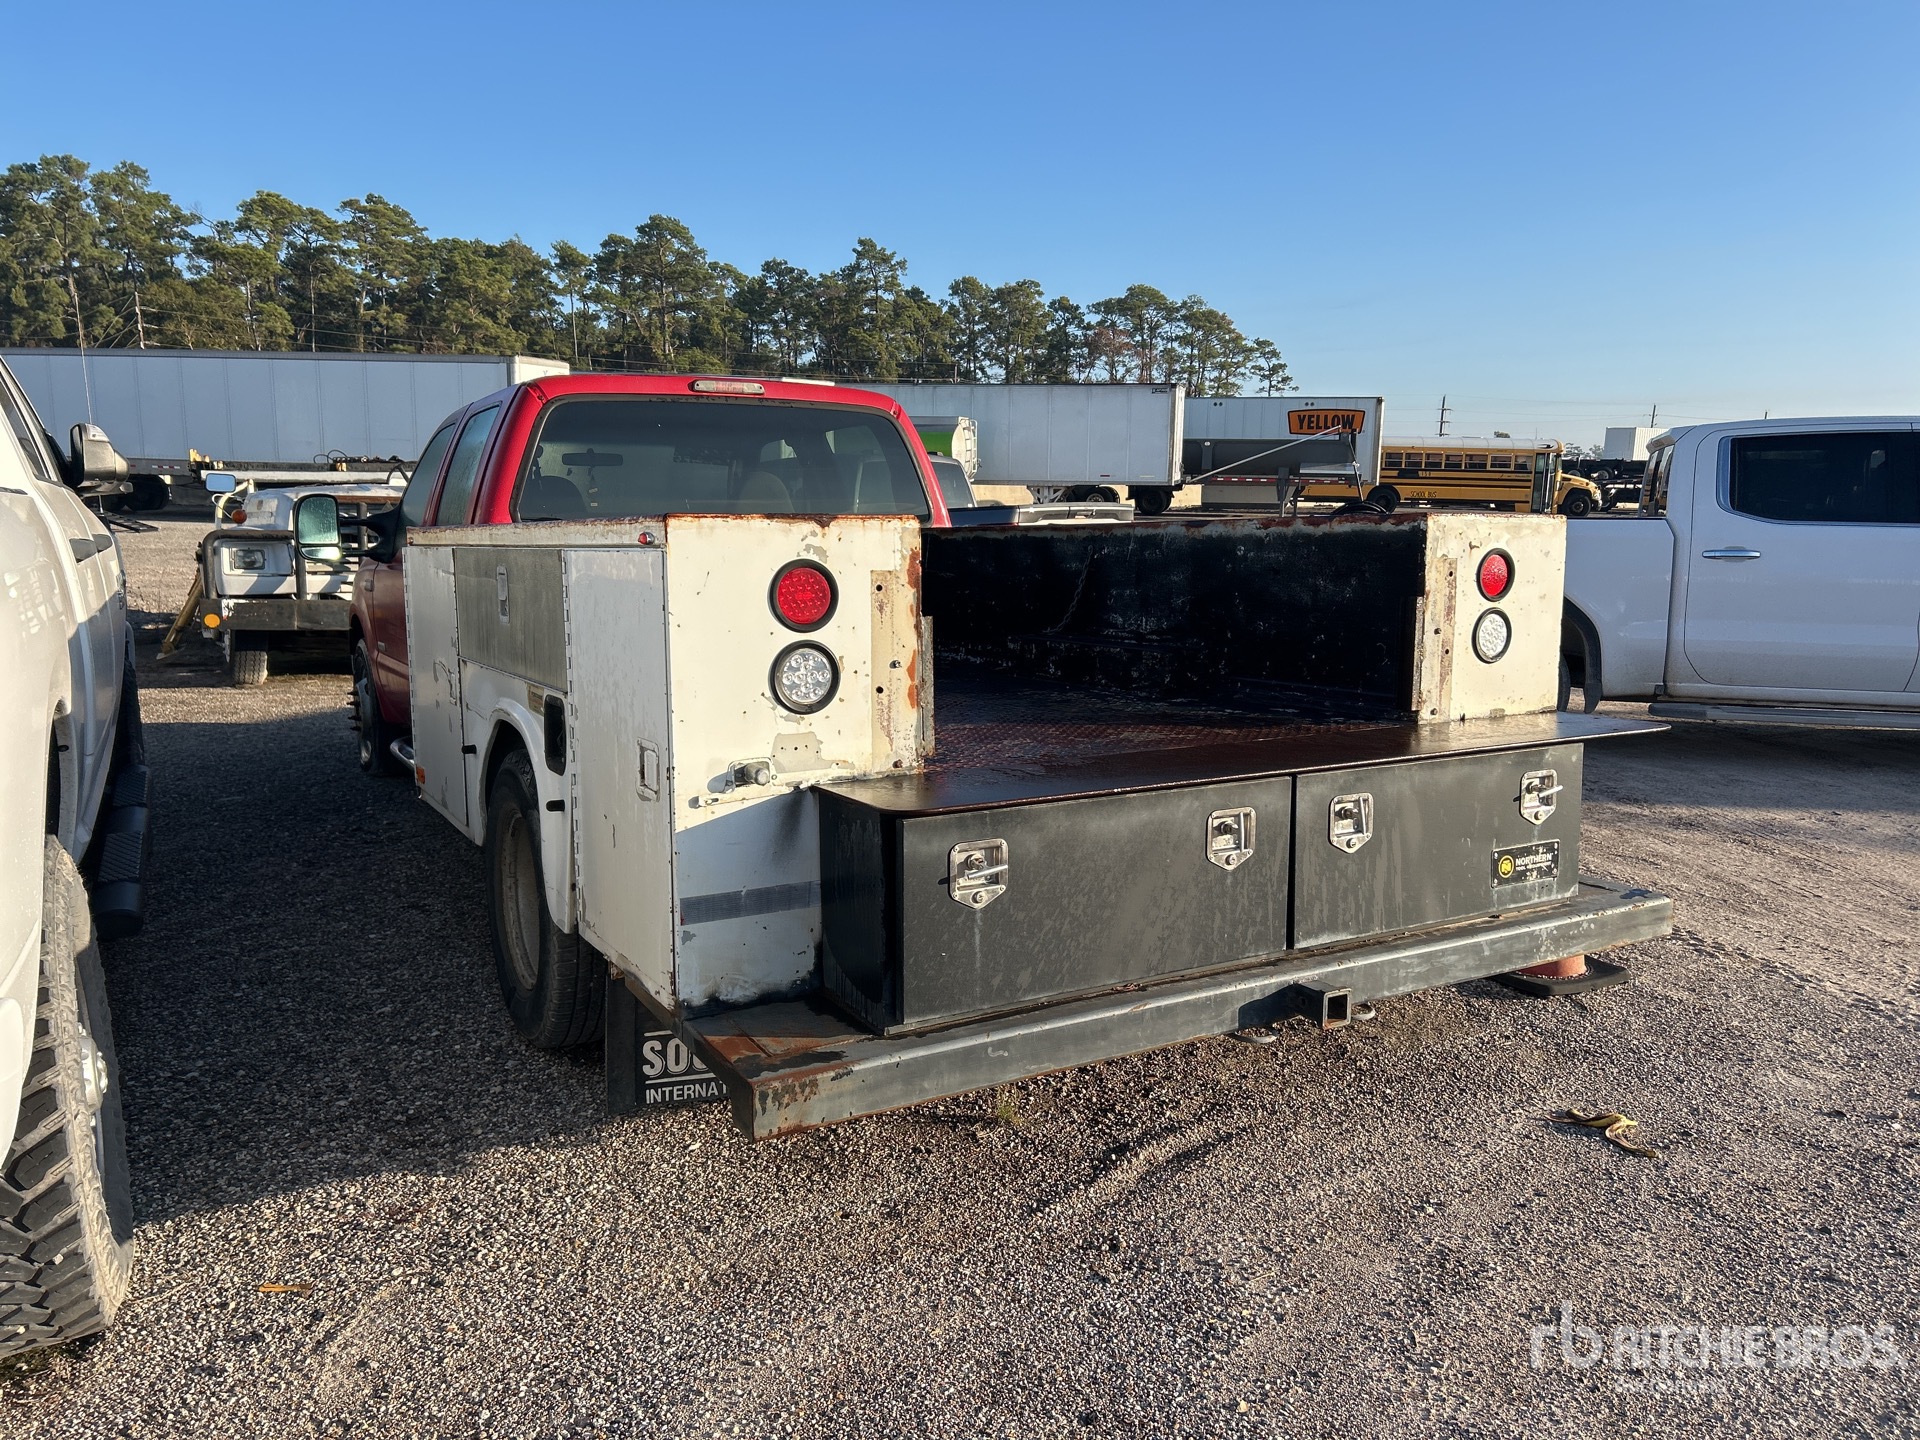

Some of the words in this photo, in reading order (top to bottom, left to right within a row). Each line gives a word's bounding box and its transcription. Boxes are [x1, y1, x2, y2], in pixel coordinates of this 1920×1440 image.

[1297, 414, 1356, 430] YELLOW
[1410, 490, 1426, 498] SCHOOL
[1427, 490, 1437, 498] BUS
[1515, 853, 1551, 866] NORTHERN
